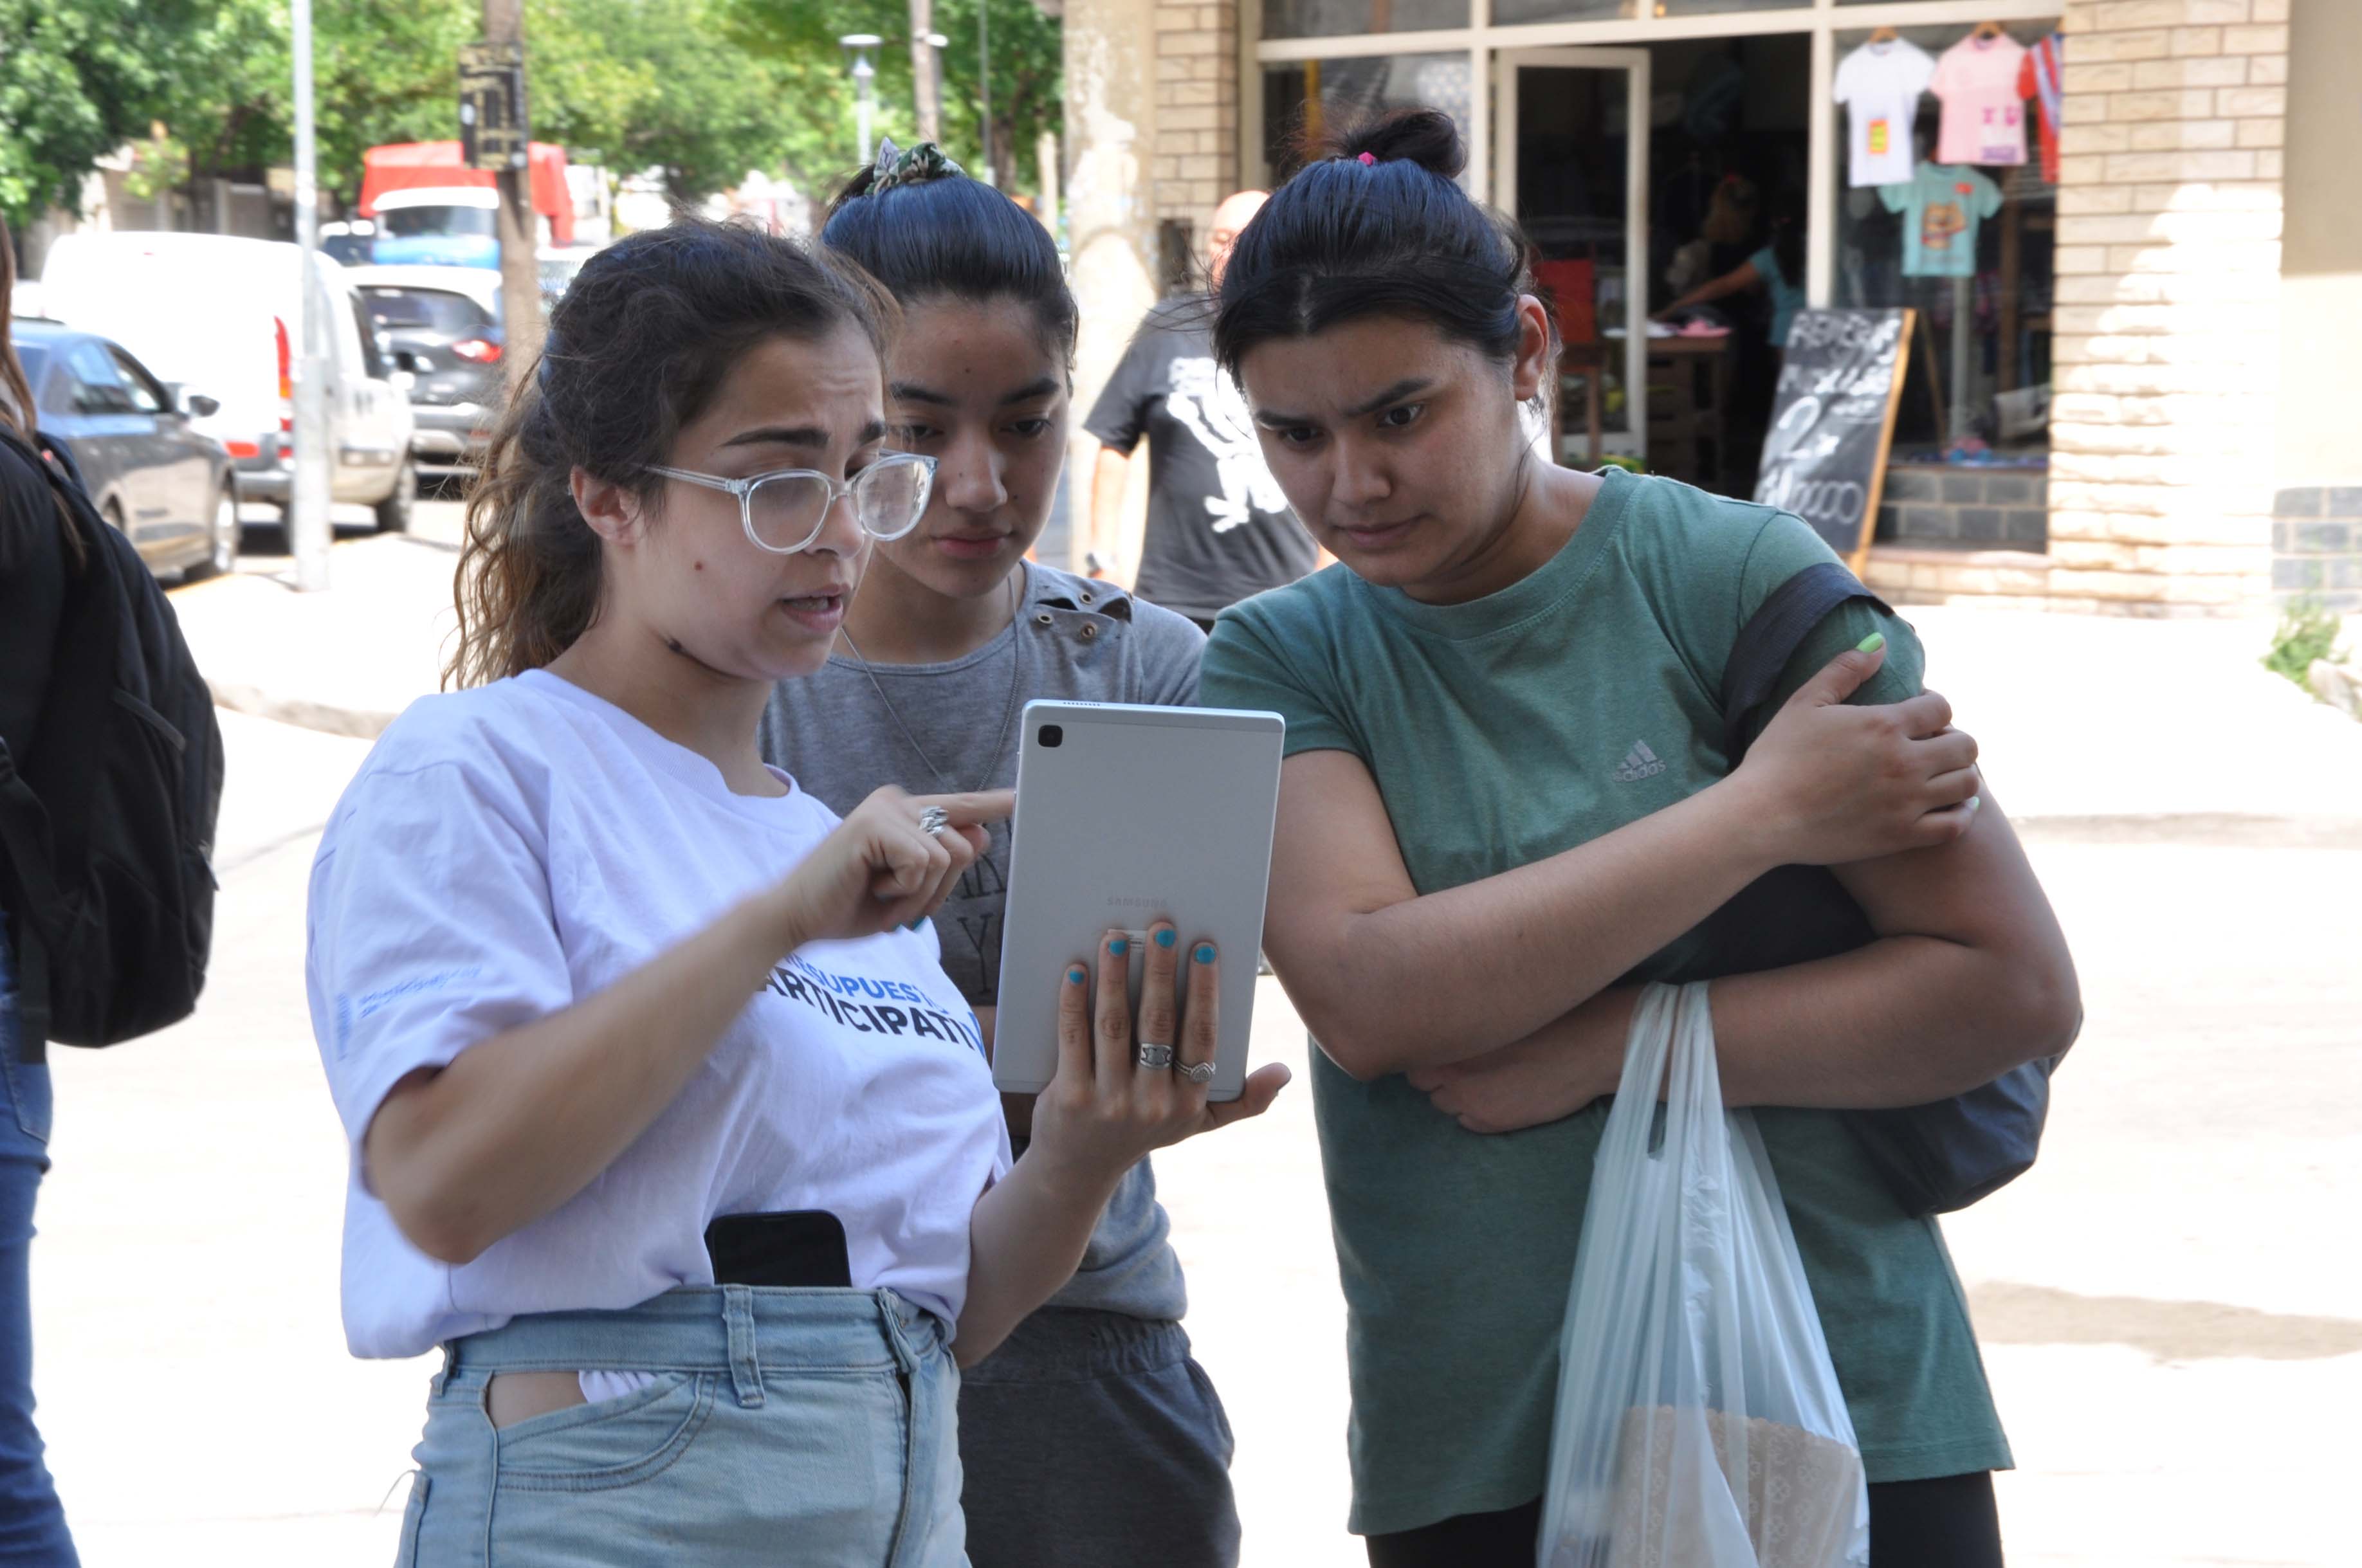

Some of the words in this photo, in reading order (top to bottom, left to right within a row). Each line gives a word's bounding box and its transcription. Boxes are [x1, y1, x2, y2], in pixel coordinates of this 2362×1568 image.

[1613, 760, 1667, 783] adidas
[1106, 896, 1168, 909] SAMSUNG
[957, 912, 1002, 996] Y
